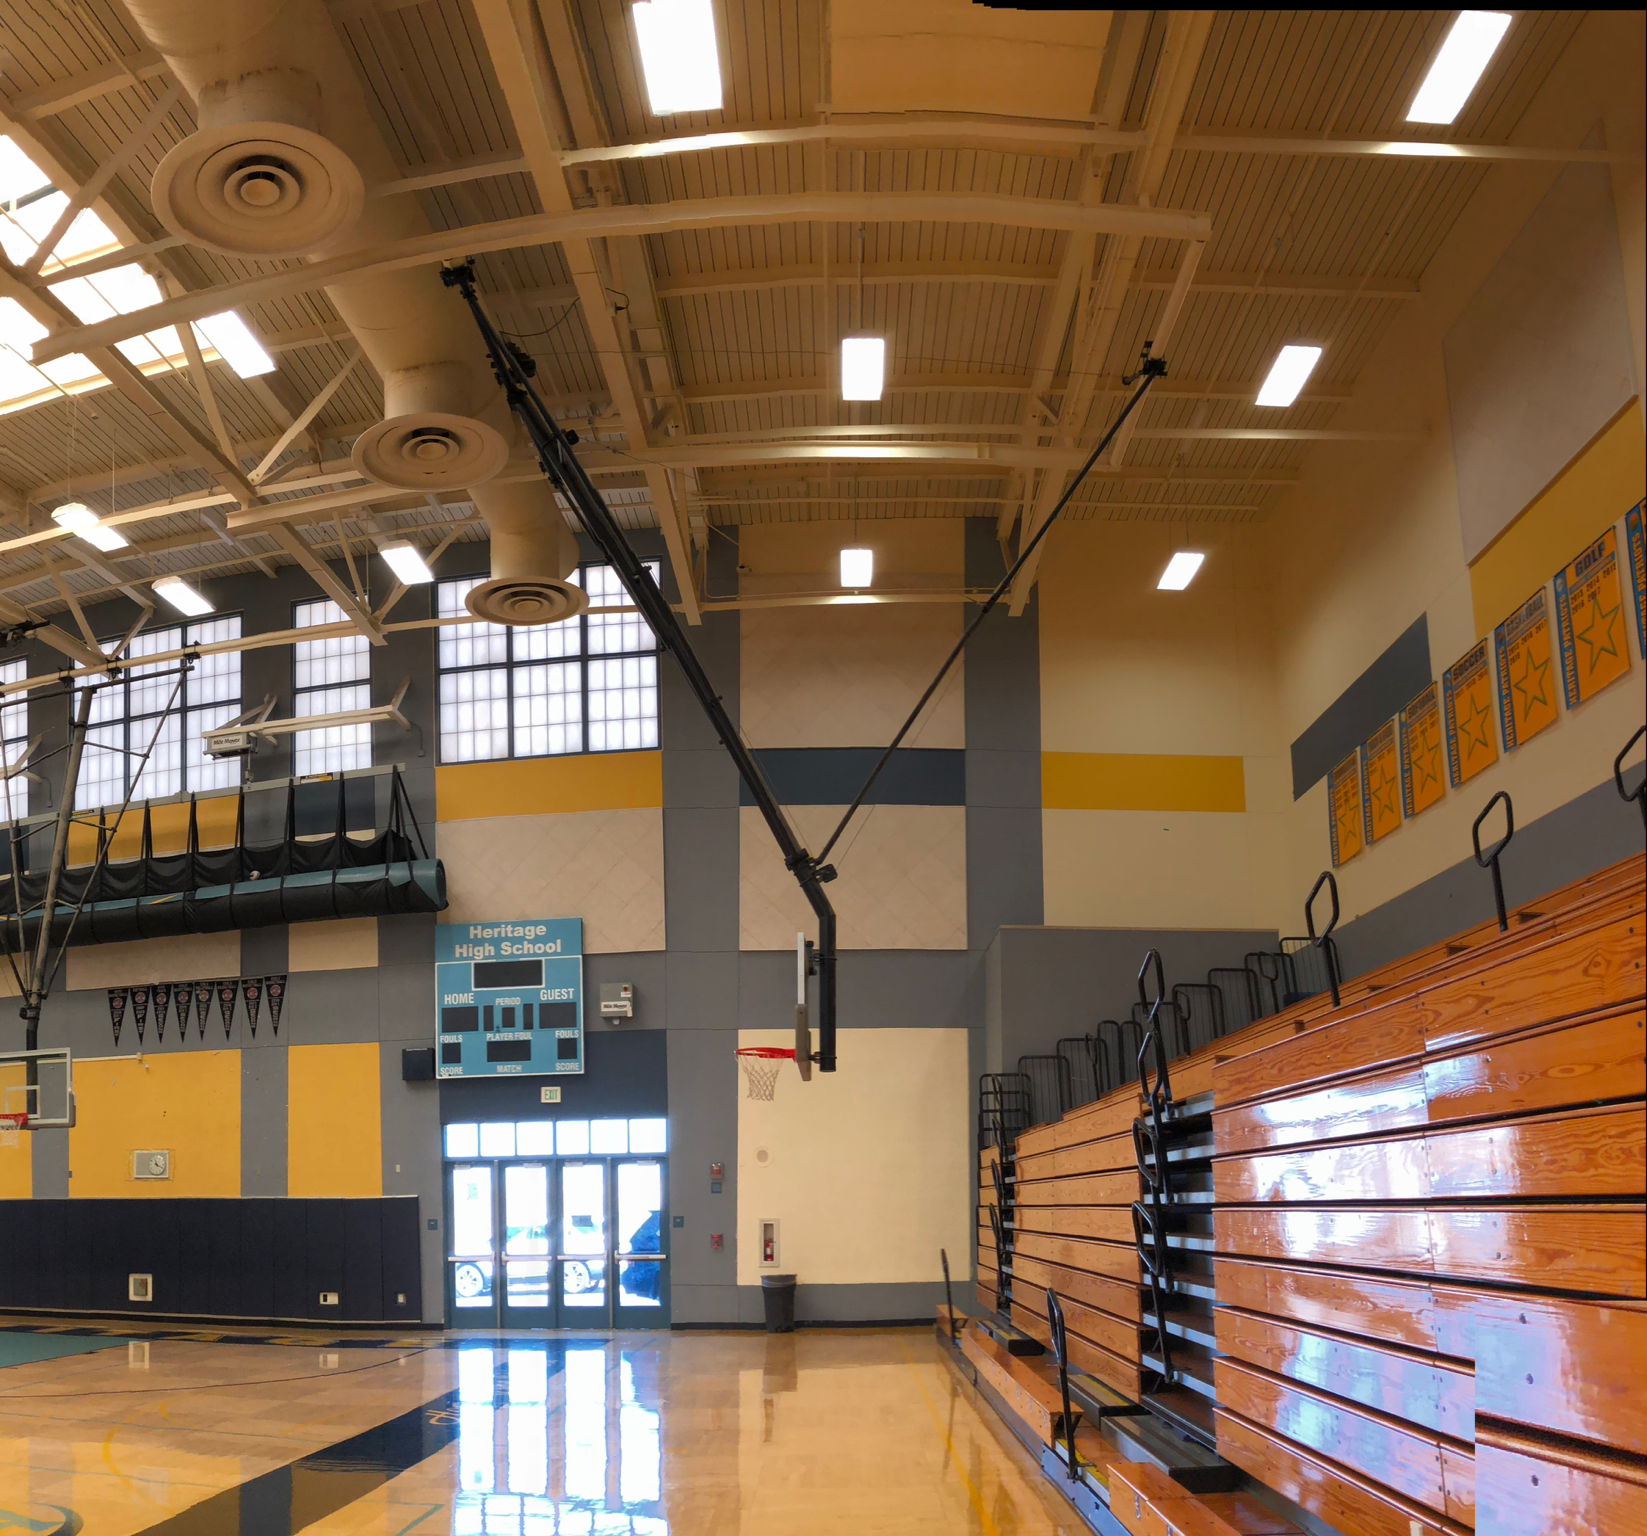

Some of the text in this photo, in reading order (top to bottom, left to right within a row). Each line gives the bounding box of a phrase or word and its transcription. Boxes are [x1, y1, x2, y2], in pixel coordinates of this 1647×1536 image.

[1574, 540, 1605, 578] GOLF
[1559, 593, 1577, 705] HERITAGE PATRIOTS
[1453, 646, 1485, 680] SOCCER
[1499, 646, 1514, 748] HERITAGE PATRIOTS
[1446, 689, 1459, 784] HERITAGE PATRIOTS
[469, 924, 547, 939] Heritage
[454, 939, 561, 959] High School
[444, 992, 474, 1005] HOME
[540, 988, 574, 1001] GUEST
[495, 997, 521, 1006] PERIOD
[440, 1034, 463, 1043] FOULS
[486, 1032, 533, 1041] PLAYER FOUL
[555, 1029, 580, 1038] FOULS
[440, 1066, 463, 1076] SCORE
[497, 1065, 522, 1073] MATCH
[555, 1062, 580, 1071] SCORE
